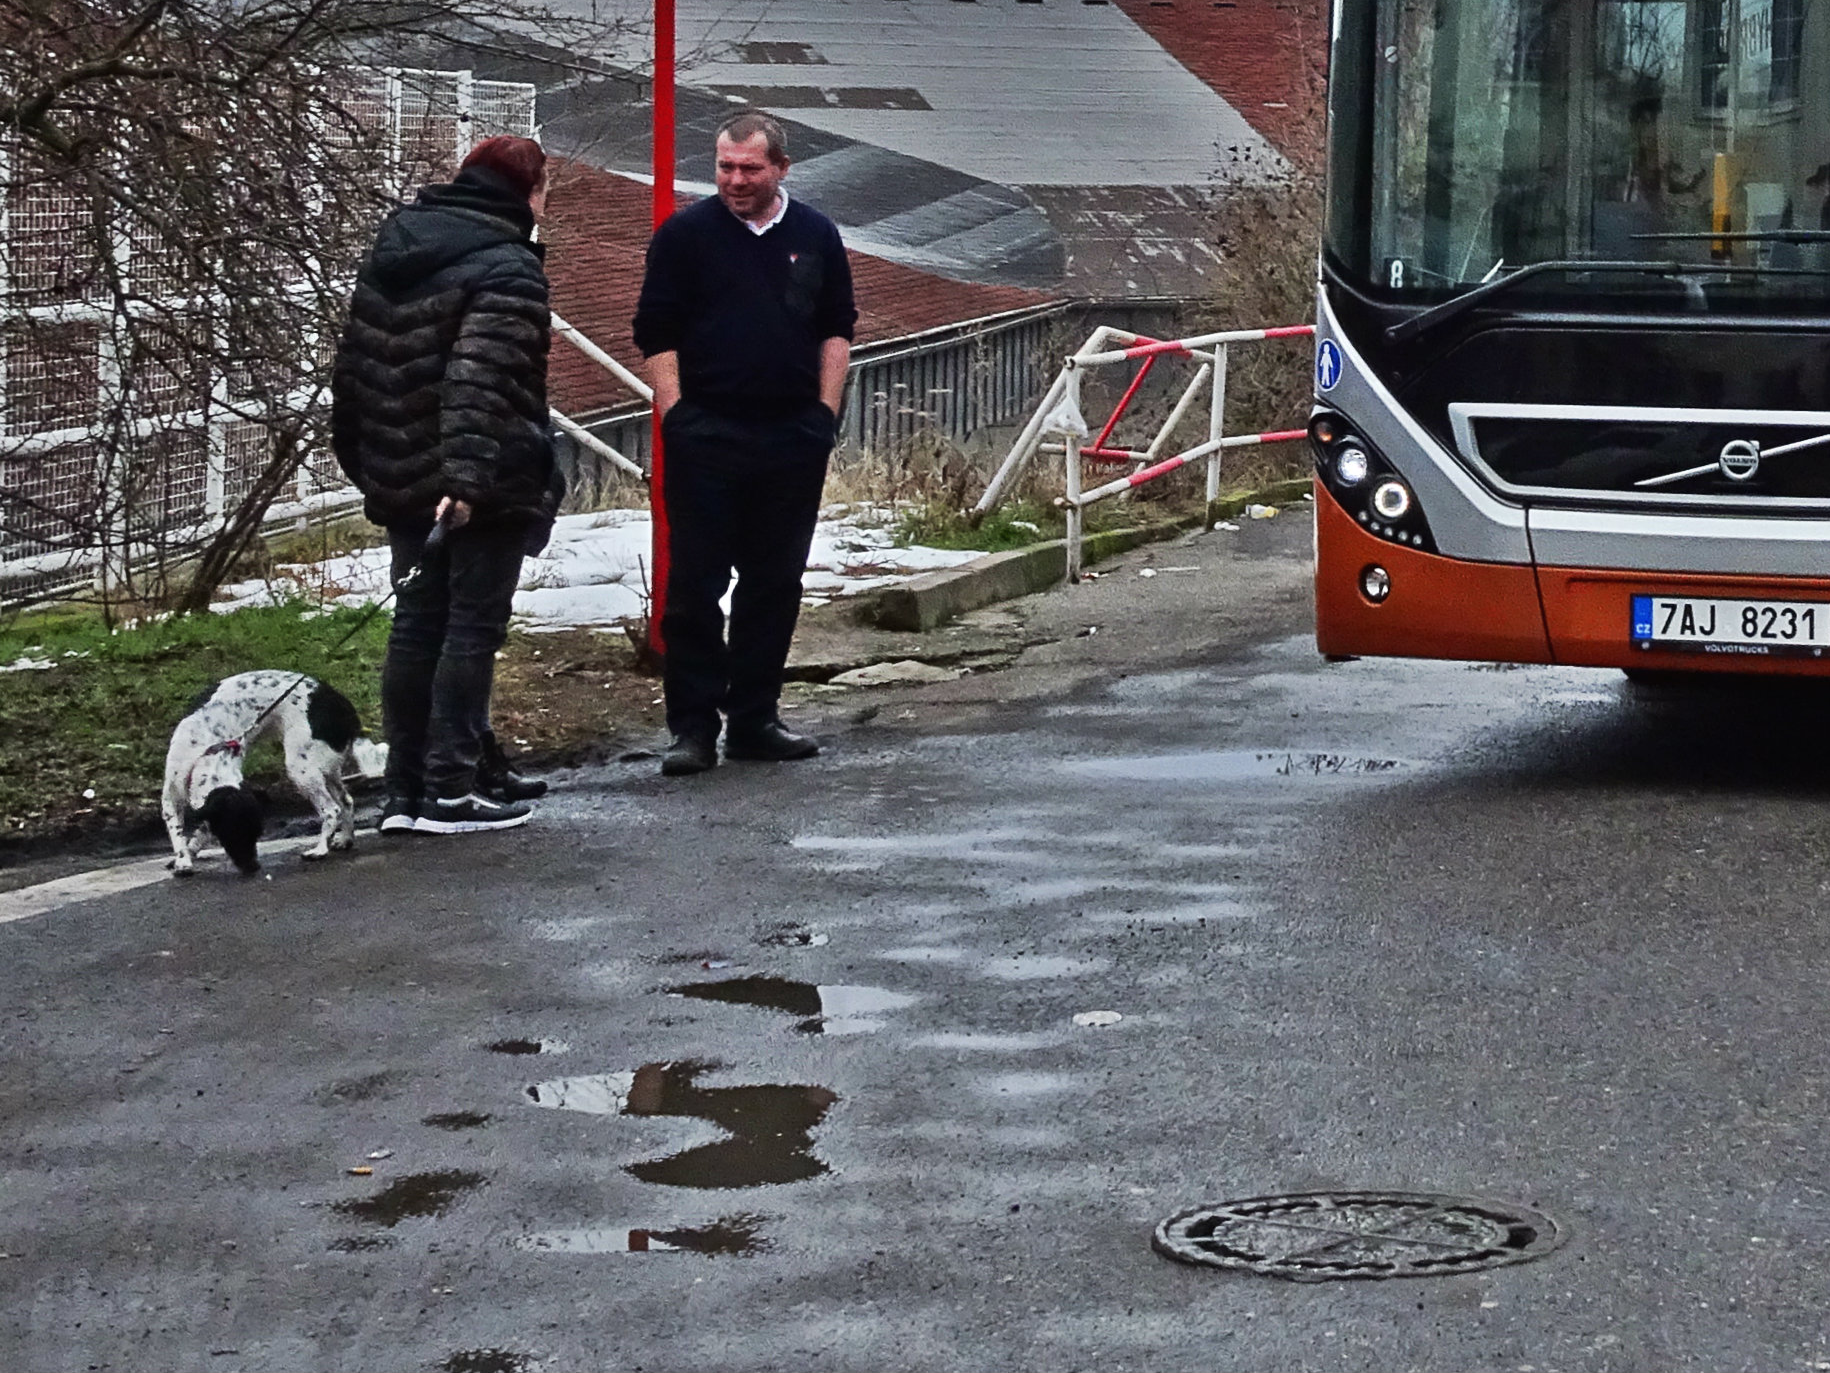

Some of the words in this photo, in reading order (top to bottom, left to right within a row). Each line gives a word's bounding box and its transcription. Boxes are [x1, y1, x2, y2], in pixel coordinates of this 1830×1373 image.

[1390, 260, 1404, 288] 8
[1722, 456, 1757, 465] VOLVO
[1636, 624, 1650, 634] CZ
[1660, 603, 1716, 636] 7AJ
[1741, 606, 1816, 640] 8231
